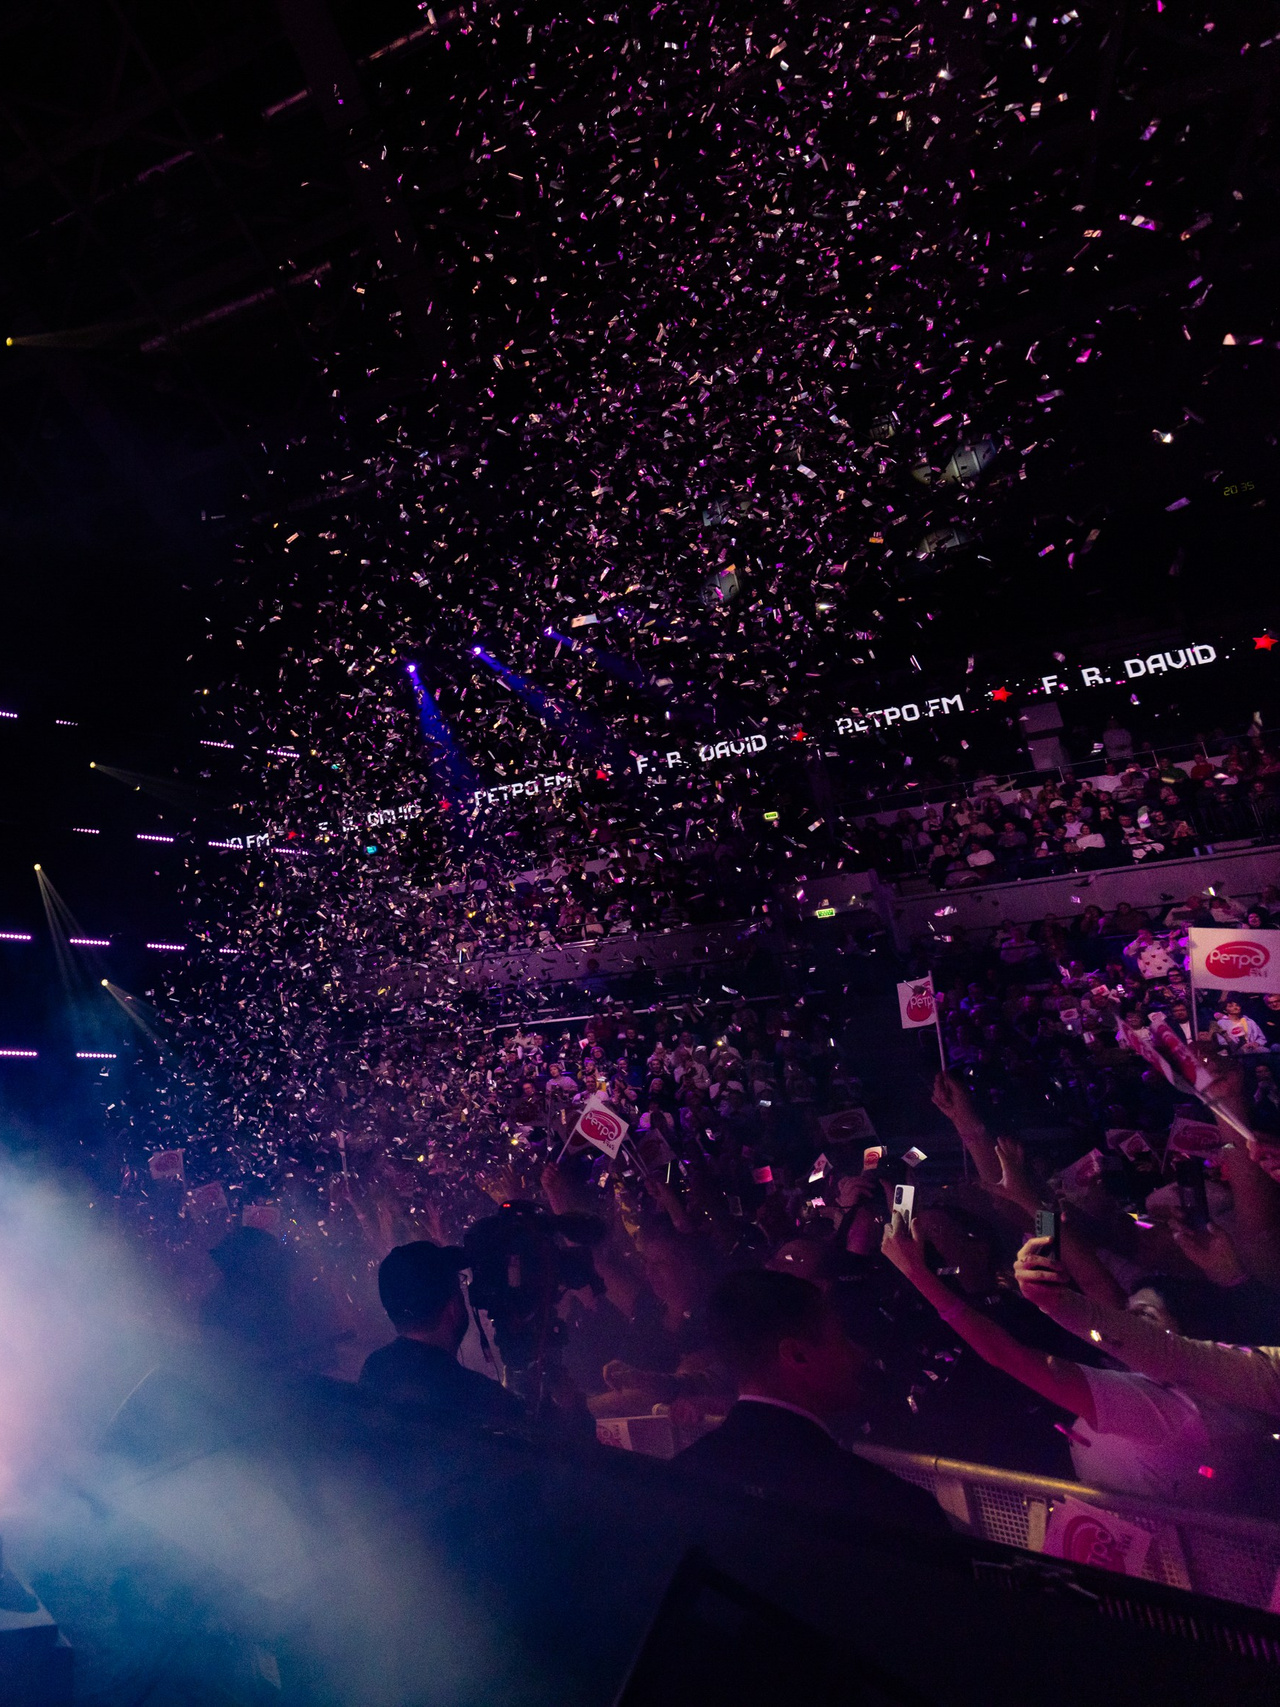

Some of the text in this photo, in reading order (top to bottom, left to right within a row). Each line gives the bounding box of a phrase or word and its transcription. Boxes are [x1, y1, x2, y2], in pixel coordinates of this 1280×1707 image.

[1081, 666, 1113, 688] R.
[1124, 644, 1218, 679] DAVID
[927, 693, 965, 719] FM
[699, 734, 768, 763] DAVID
